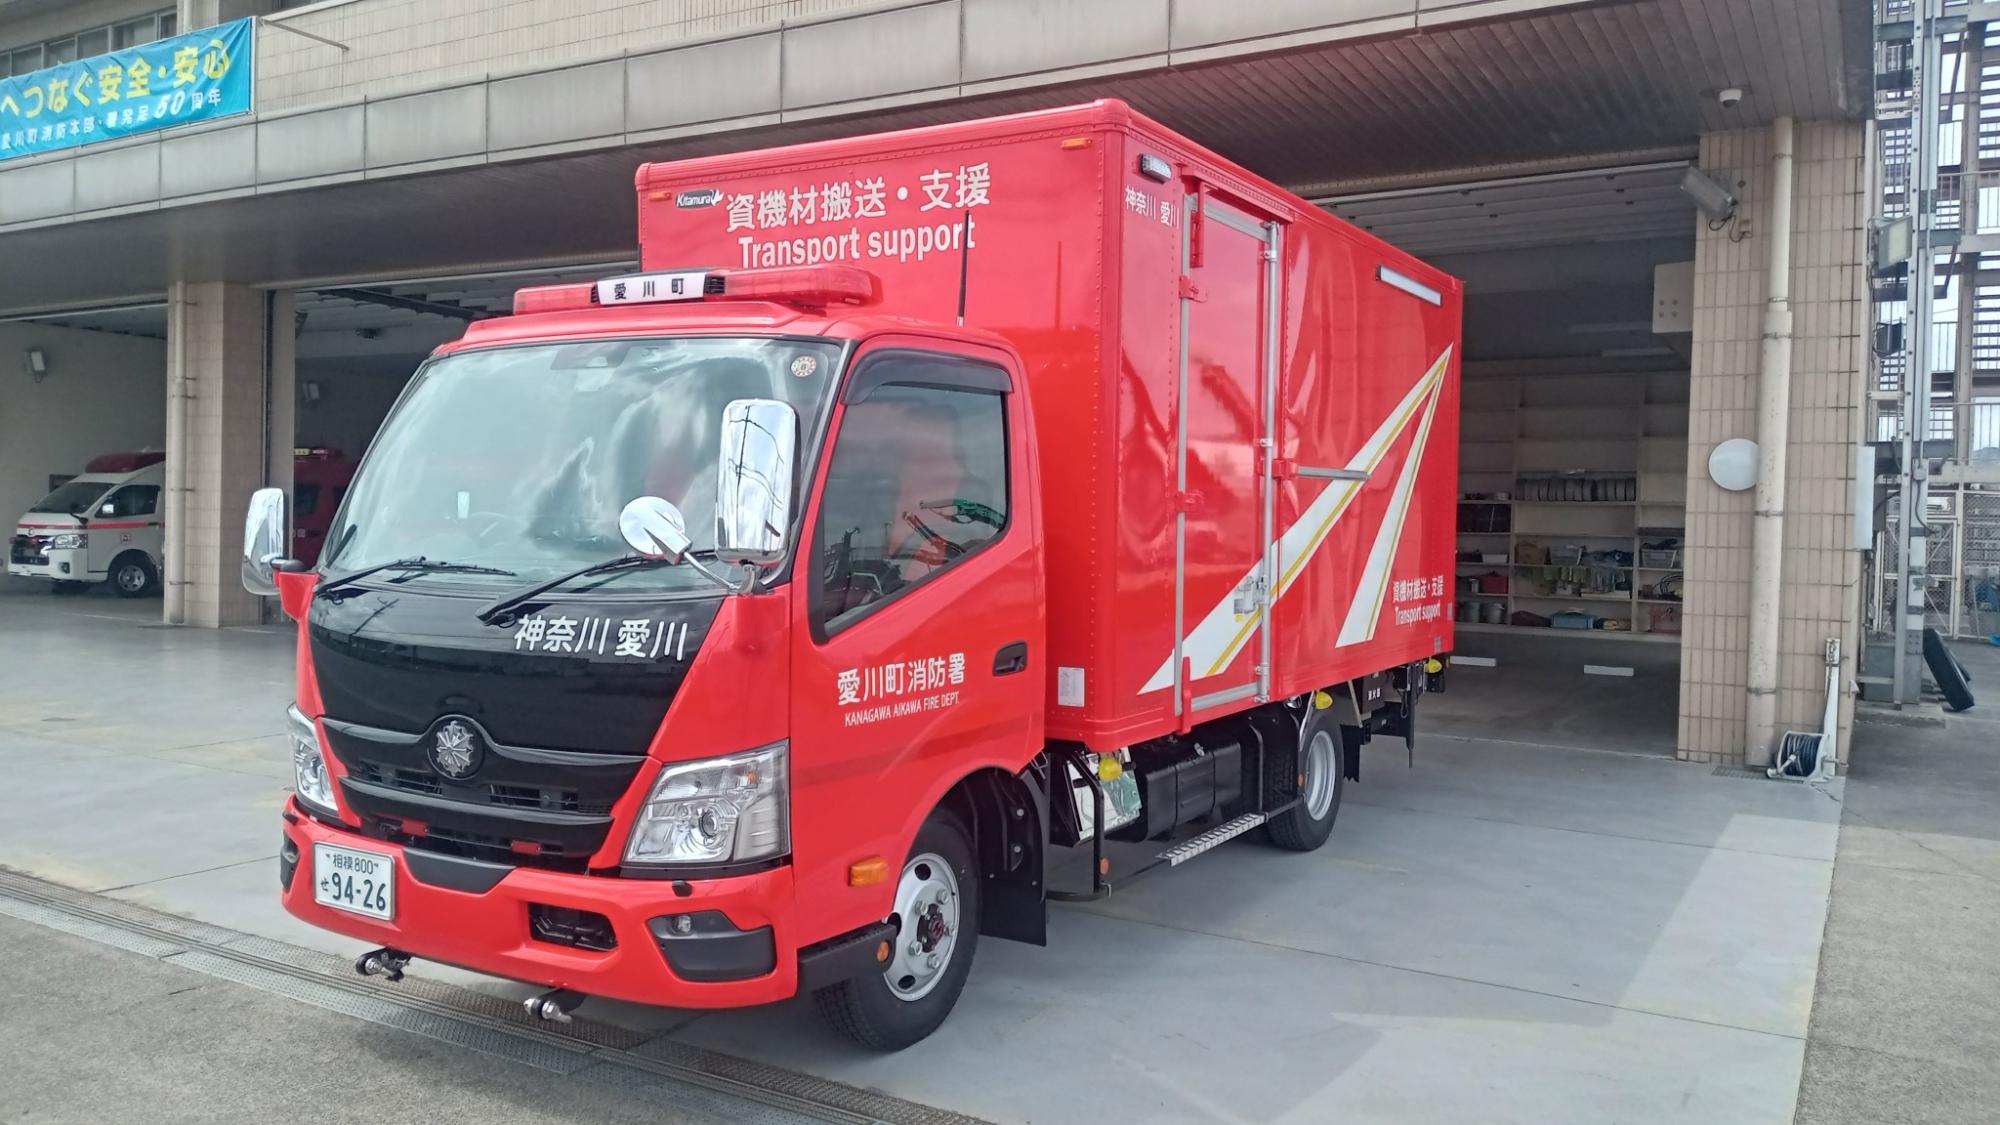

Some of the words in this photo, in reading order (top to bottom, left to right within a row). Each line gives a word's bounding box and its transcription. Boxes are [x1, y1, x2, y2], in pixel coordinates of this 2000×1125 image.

[676, 192, 711, 207] Kitamura
[726, 161, 991, 232] 資機材搬送・支援
[1125, 184, 1156, 221] 神奈川
[1160, 200, 1180, 230] 愛川
[738, 230, 860, 268] Transport
[868, 214, 976, 263] support
[614, 278, 684, 300] 愛川町
[1393, 575, 1444, 604] 資機材搬送・支援
[1394, 605, 1421, 629] Transport
[1422, 600, 1441, 622] support
[514, 614, 610, 655] 神奈川
[614, 619, 688, 661] 愛川
[837, 652, 966, 706] 愛川町消防署
[844, 704, 892, 727] KANAGAWA
[893, 699, 922, 718] AIKAWA
[923, 695, 940, 711] FIRE
[941, 691, 960, 707] DEPT.
[333, 853, 374, 875] 相模800
[320, 877, 330, 892] せ
[331, 872, 387, 911] 94-26
